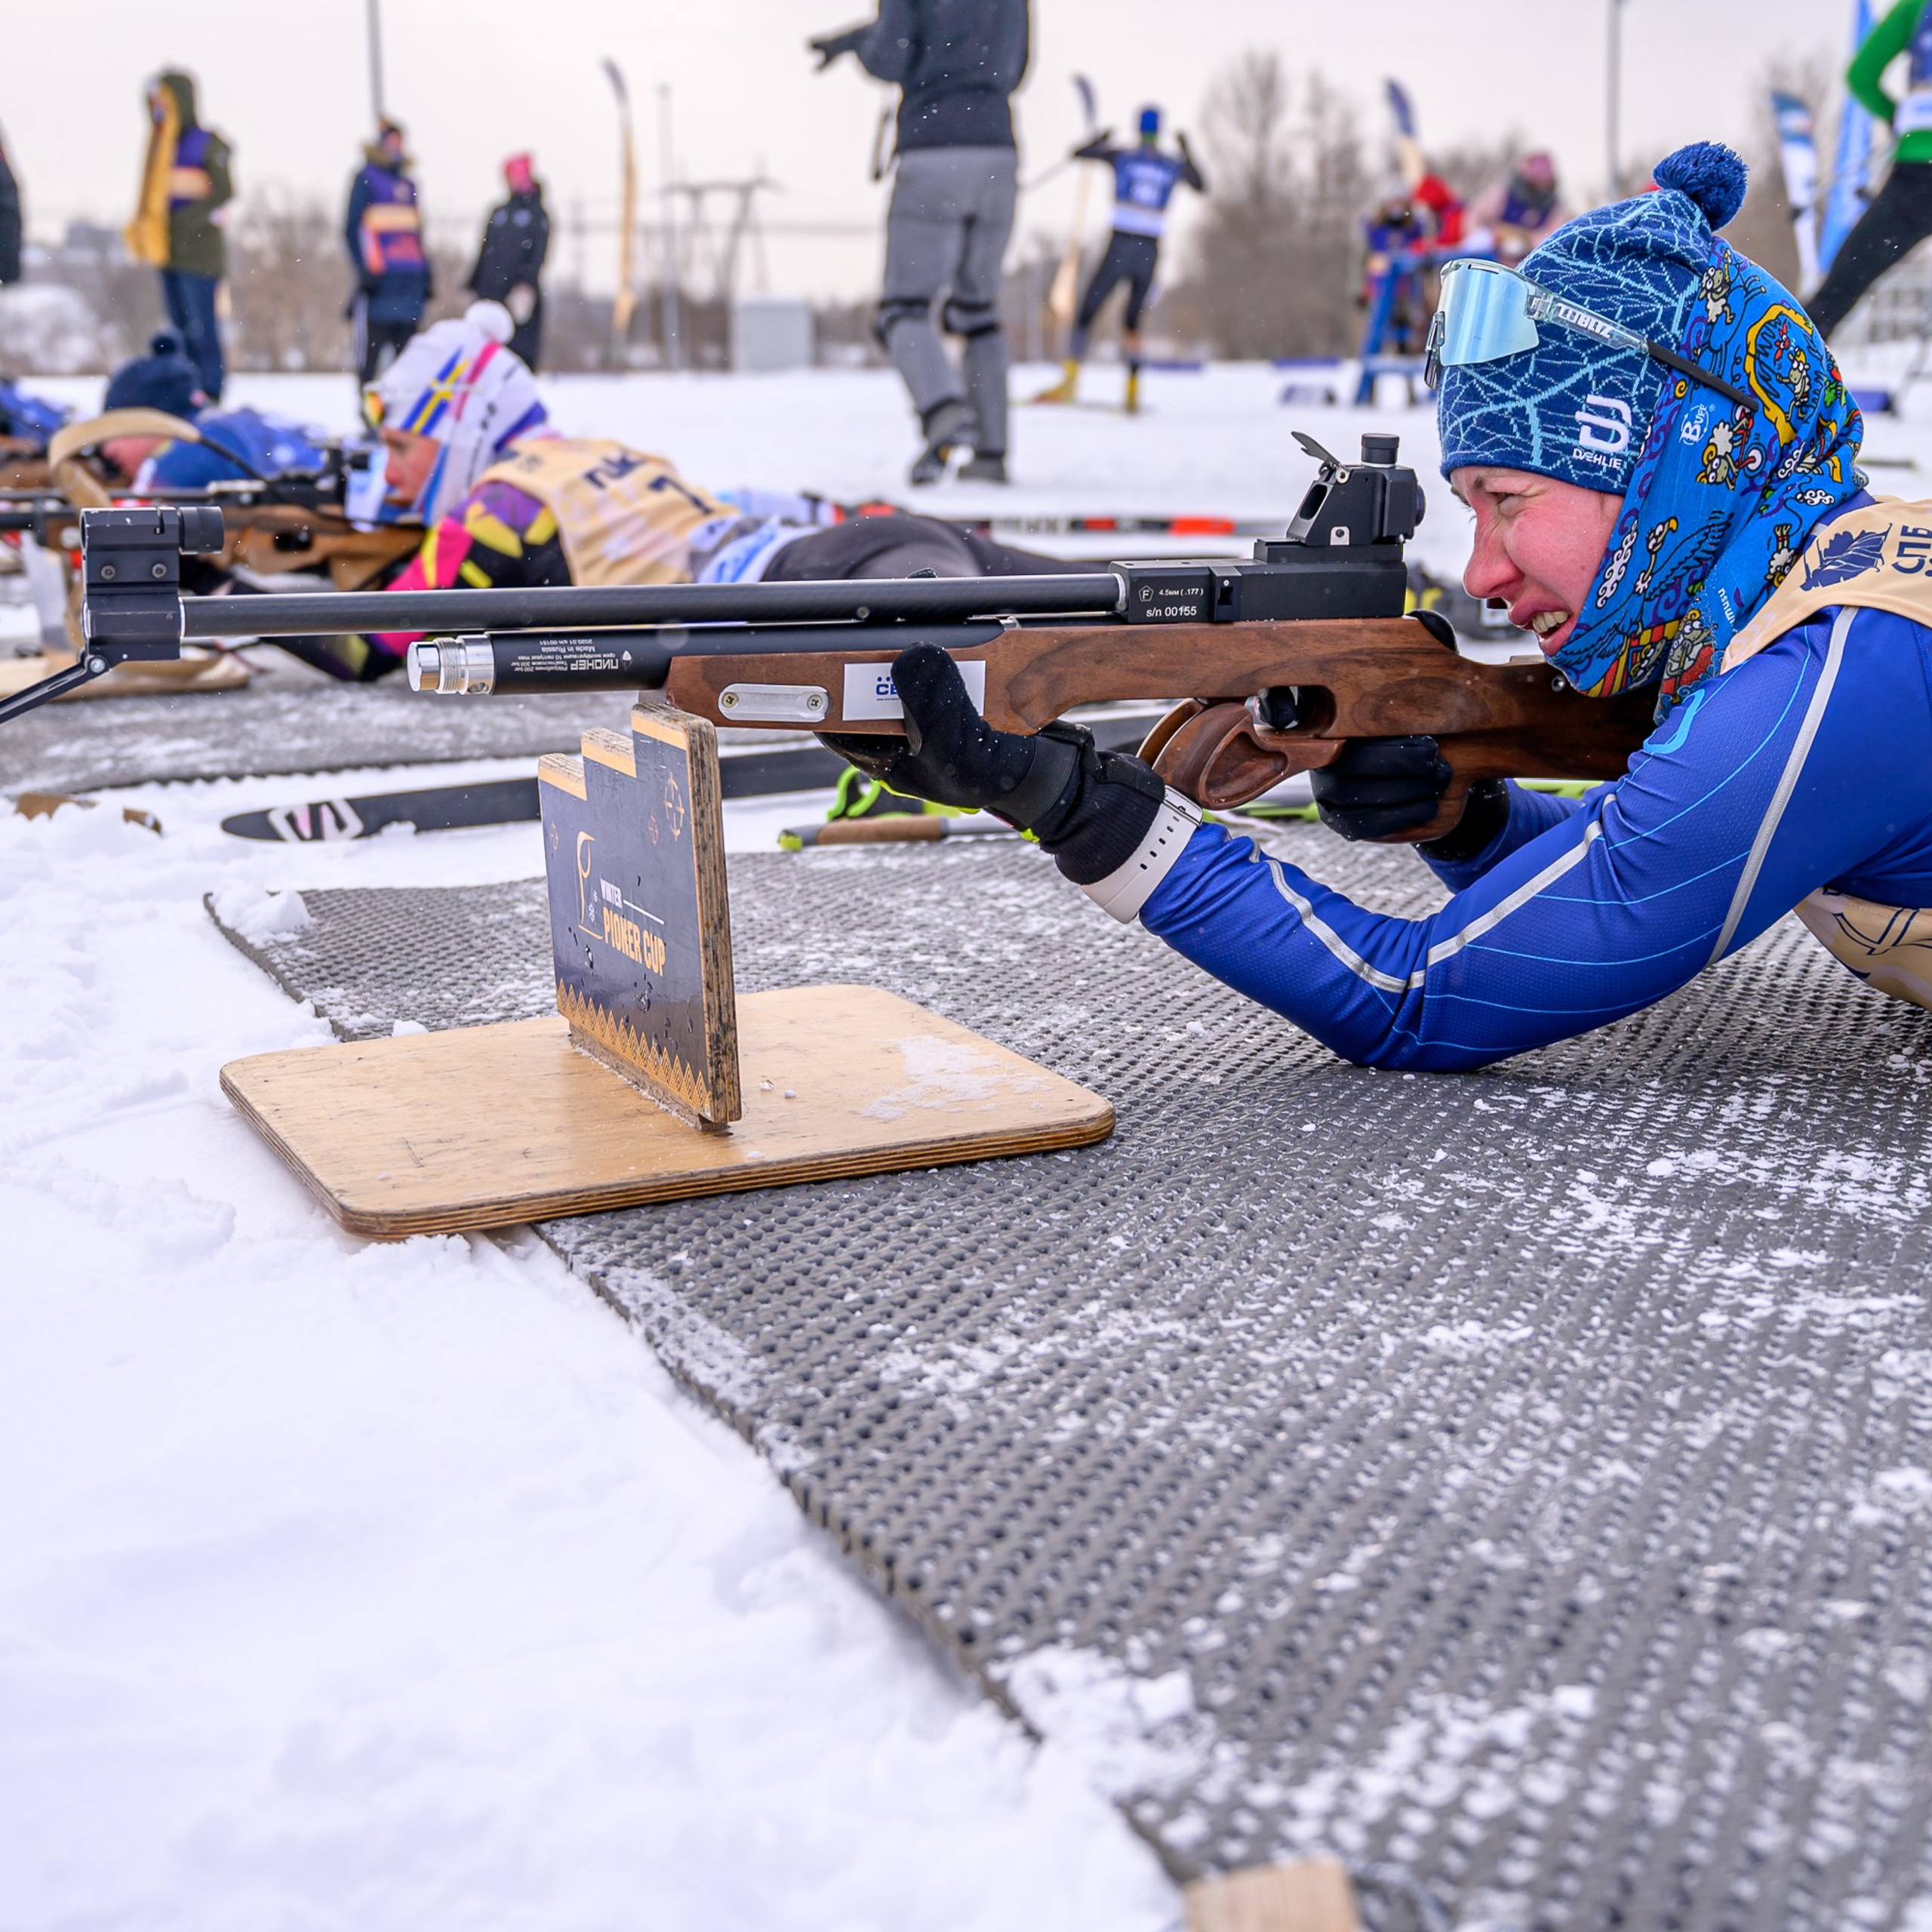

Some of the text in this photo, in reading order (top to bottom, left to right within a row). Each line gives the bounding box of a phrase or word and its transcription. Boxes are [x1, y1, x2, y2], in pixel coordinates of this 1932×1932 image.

[1146, 606, 1197, 617] s/n 00155
[570, 658, 619, 671] ПИОНЕР
[642, 930, 666, 977] CUP
